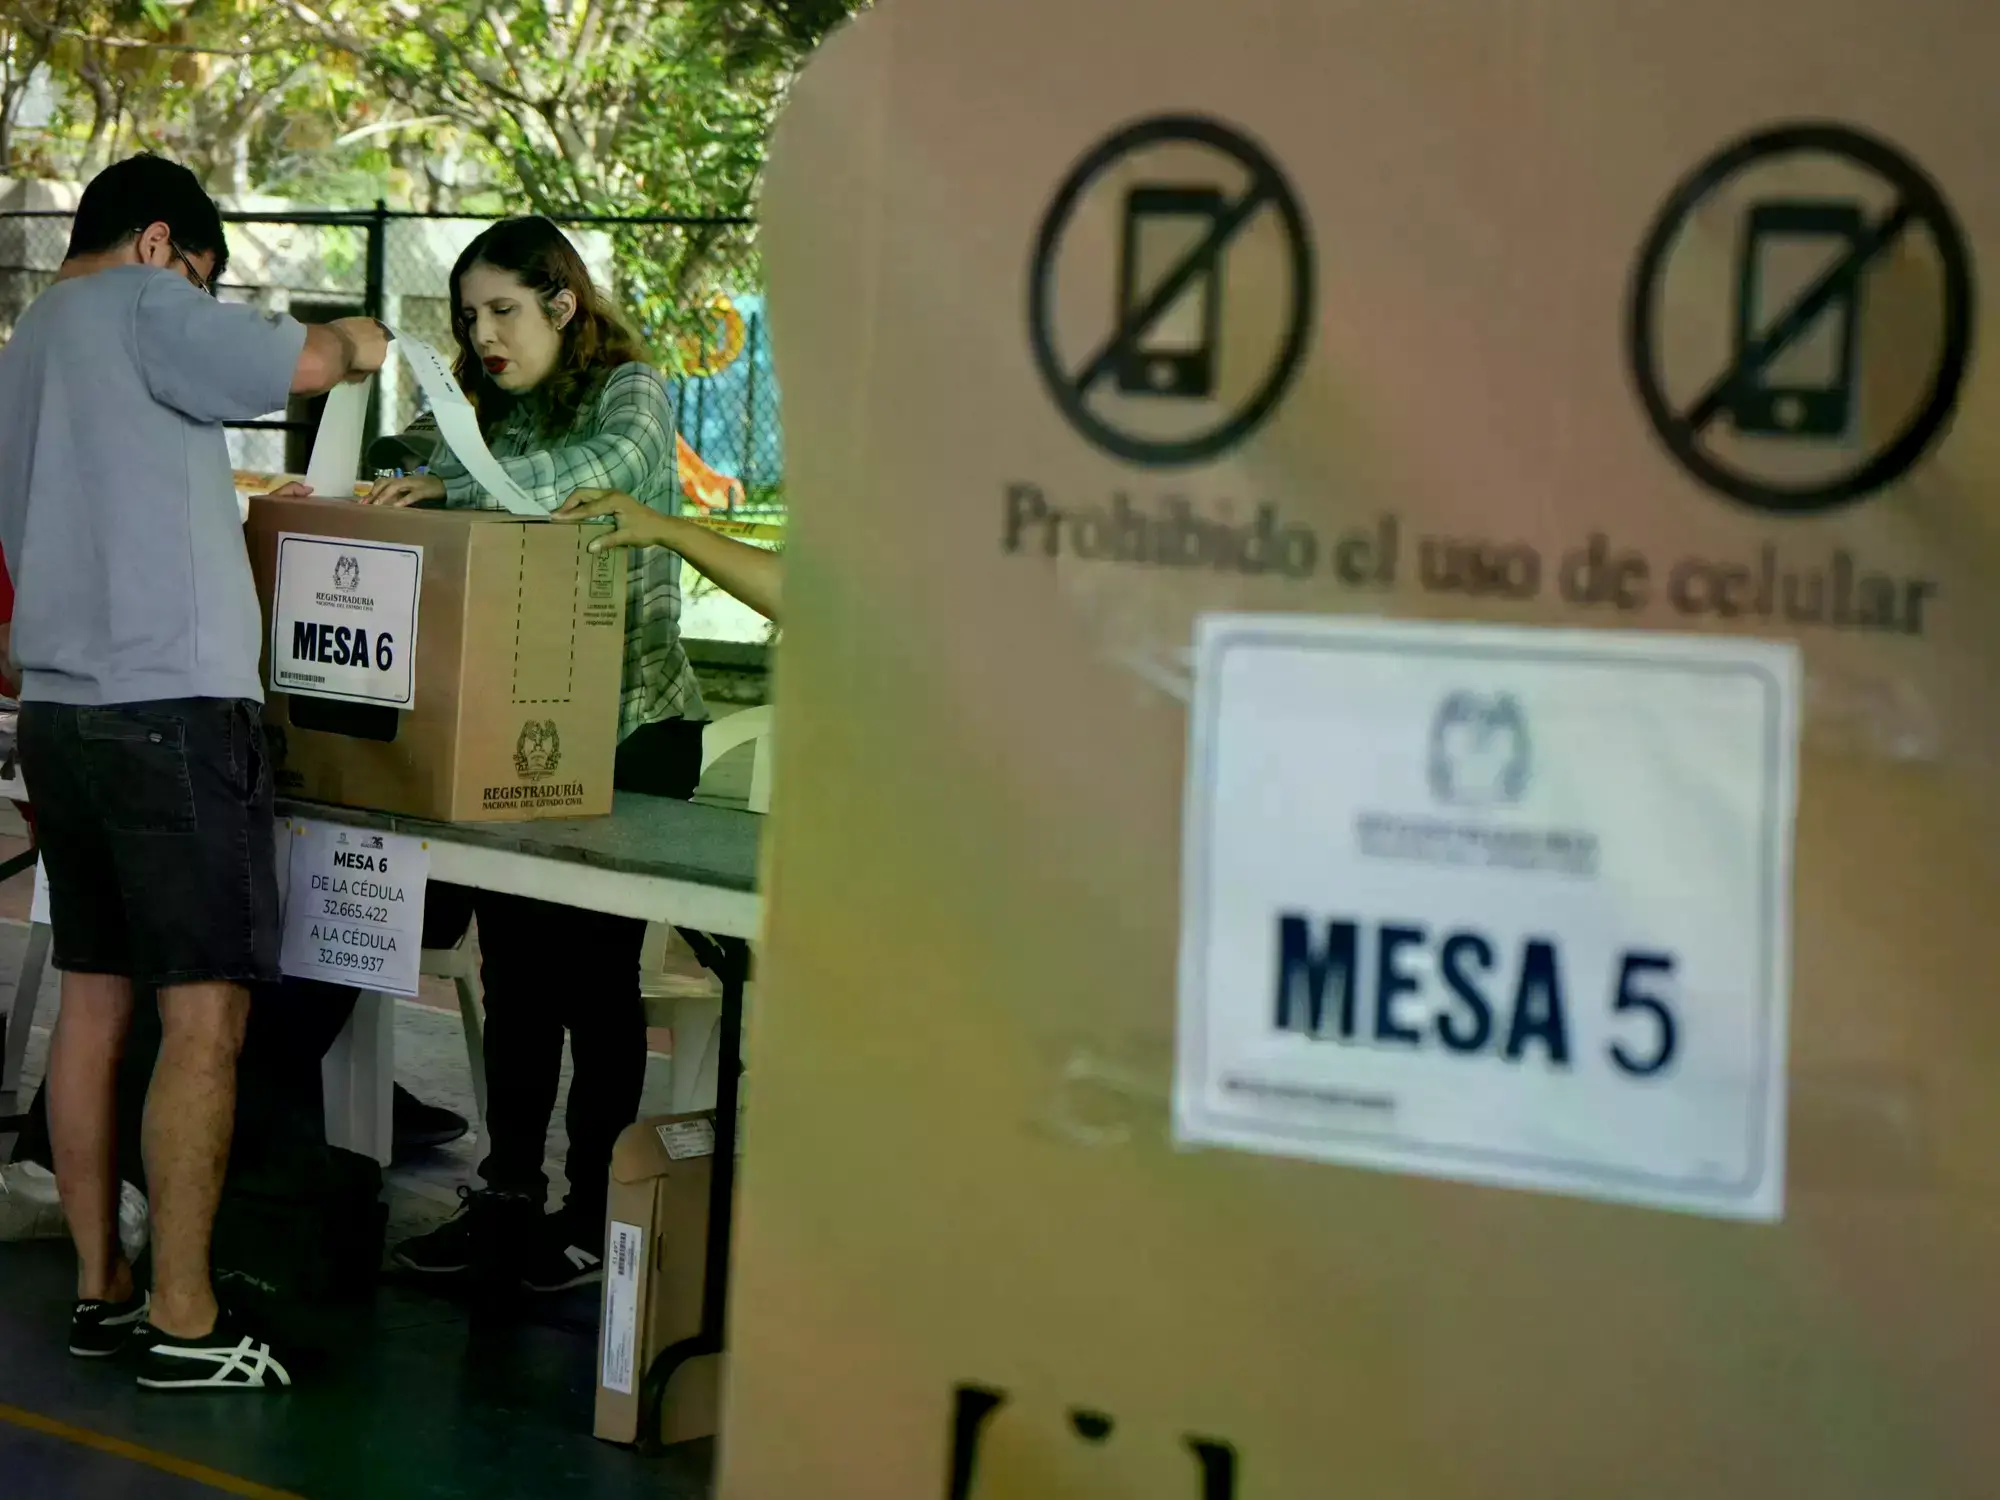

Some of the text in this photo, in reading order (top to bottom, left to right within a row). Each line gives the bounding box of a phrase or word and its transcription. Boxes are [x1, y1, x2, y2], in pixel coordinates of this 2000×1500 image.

[1000, 482, 1939, 635] Prohibido el uso de celular
[292, 620, 393, 672] MESA 6
[483, 780, 584, 800] REGISTRADURÍA
[482, 797, 583, 810] NACIONAL DEL ESTADO CIVIL
[333, 850, 388, 873] MESA 6
[311, 875, 405, 902] DE LA CÉDULA
[323, 899, 388, 923] 32.665.422
[310, 925, 397, 951] A LA CÉDULA
[318, 948, 384, 972] 32.699.937
[1272, 912, 1678, 1078] MESA 5
